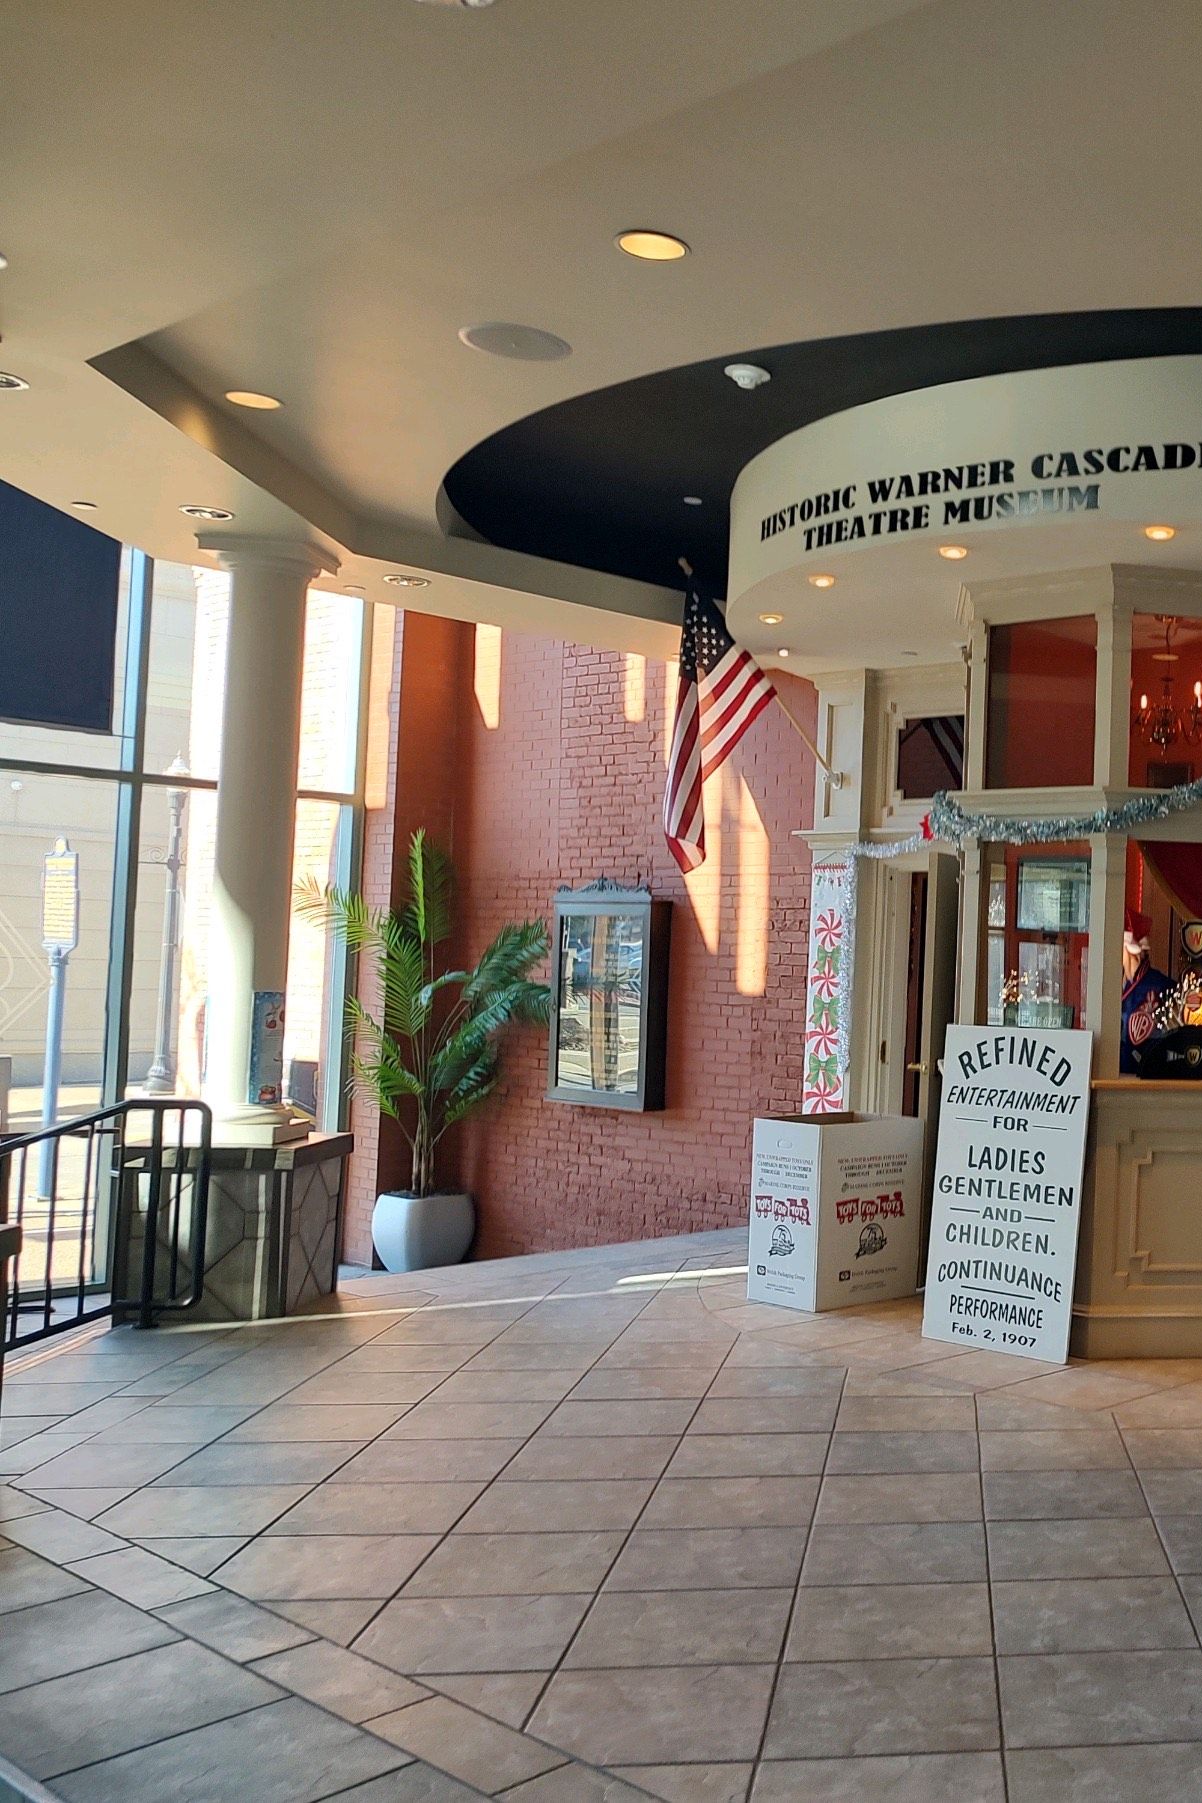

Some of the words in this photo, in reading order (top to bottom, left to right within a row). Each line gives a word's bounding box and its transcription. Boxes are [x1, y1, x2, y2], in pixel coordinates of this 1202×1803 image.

[760, 485, 857, 542] HISTORIC
[867, 459, 1016, 504] WARNER
[803, 504, 931, 552] THEATRE
[943, 484, 1101, 526] MUSEUM
[1131, 1014, 1150, 1042] WB
[958, 1036, 1072, 1087] REFINED
[947, 1086, 1081, 1115] ENTERTAINMENT
[993, 1116, 1029, 1132] FOR
[968, 1145, 1046, 1175] LADIES
[939, 1175, 1074, 1207] GENTLEMEN
[756, 1198, 771, 1211] TOYS
[774, 1203, 786, 1215] FOR
[791, 1207, 808, 1219] TOTS
[837, 1201, 858, 1215] TOYS
[861, 1201, 877, 1213] FOR
[882, 1199, 901, 1212] TOTS
[982, 1207, 1022, 1223] AND
[946, 1222, 1056, 1256] CHILDREN.
[938, 1259, 1062, 1303] CONTINUANCE
[950, 1294, 1043, 1329] PERFORMANCE
[952, 1322, 977, 1337] Feb.
[983, 1329, 996, 1342] 2,
[1002, 1332, 1037, 1348] 1907
